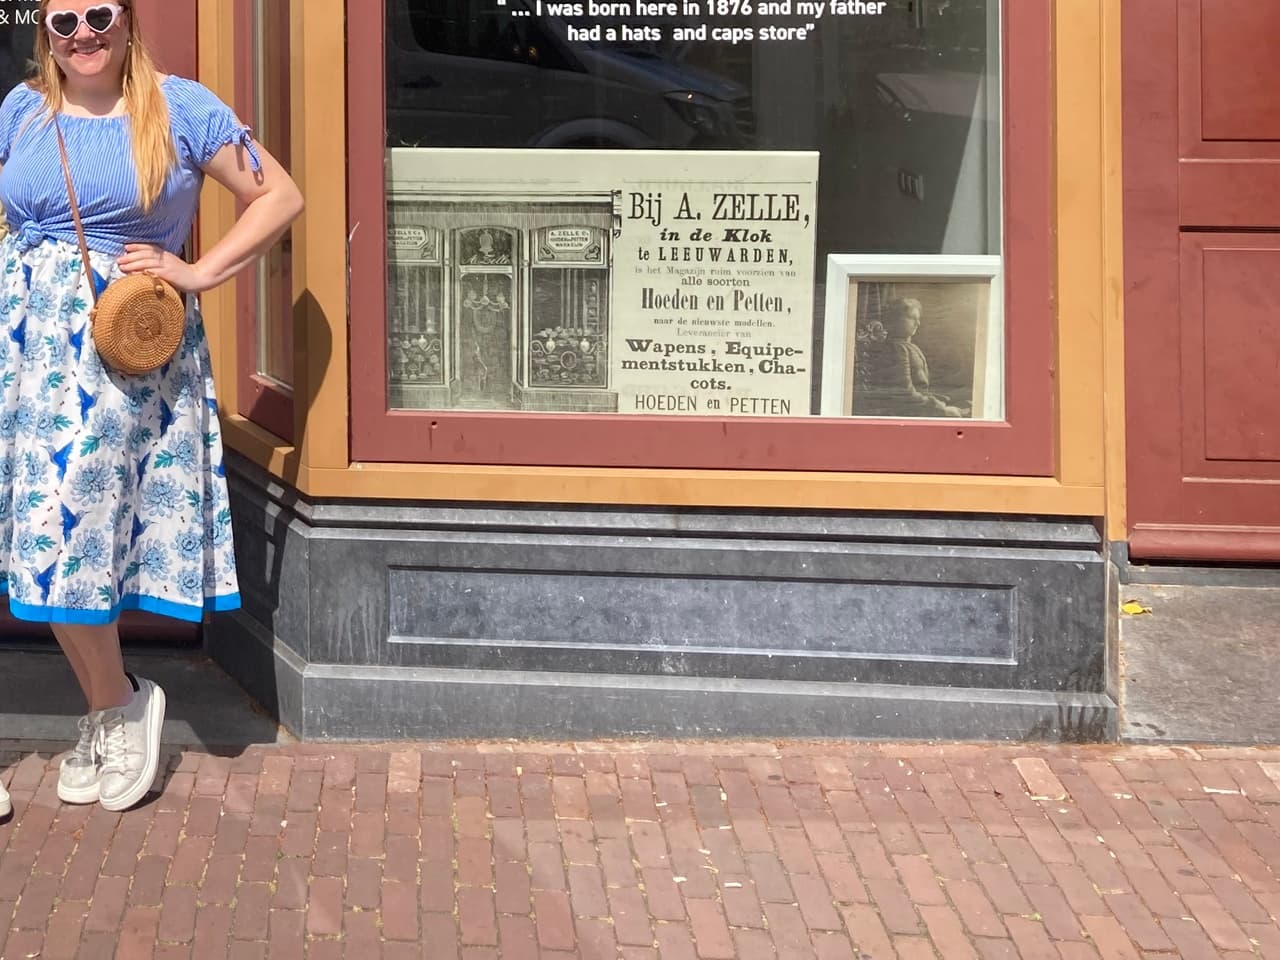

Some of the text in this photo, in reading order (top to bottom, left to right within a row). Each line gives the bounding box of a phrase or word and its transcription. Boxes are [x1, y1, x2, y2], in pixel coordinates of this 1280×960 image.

[536, 0, 542, 16] I
[547, 3, 584, 16] was
[588, 0, 631, 16] born
[636, 0, 677, 16] here
[683, 0, 700, 16] in
[707, 0, 752, 15] 1876
[797, 2, 825, 19] my
[567, 25, 601, 41] had
[606, 28, 617, 41] a
[622, 25, 661, 41] hats
[673, 24, 706, 41] and
[712, 27, 754, 44] caps
[627, 192, 810, 228] Bij A. ZELLE,
[660, 228, 773, 242] in de Klok
[638, 247, 793, 266] te LEEUWARDEN,
[635, 266, 643, 274] is
[647, 266, 661, 274] het
[666, 266, 706, 277] Magazijn
[710, 267, 732, 276] ruim
[737, 268, 775, 277] voorzien
[681, 276, 750, 287] alle soorten
[642, 287, 698, 310] Hoeden
[706, 294, 724, 311] en
[654, 317, 776, 327] naar de nieuwste modellen.
[725, 341, 804, 357] Equipe-
[621, 358, 806, 375] mentstukken, Cha-
[690, 378, 732, 390] cots.
[635, 394, 791, 414] HOEDEN en PETTEN
